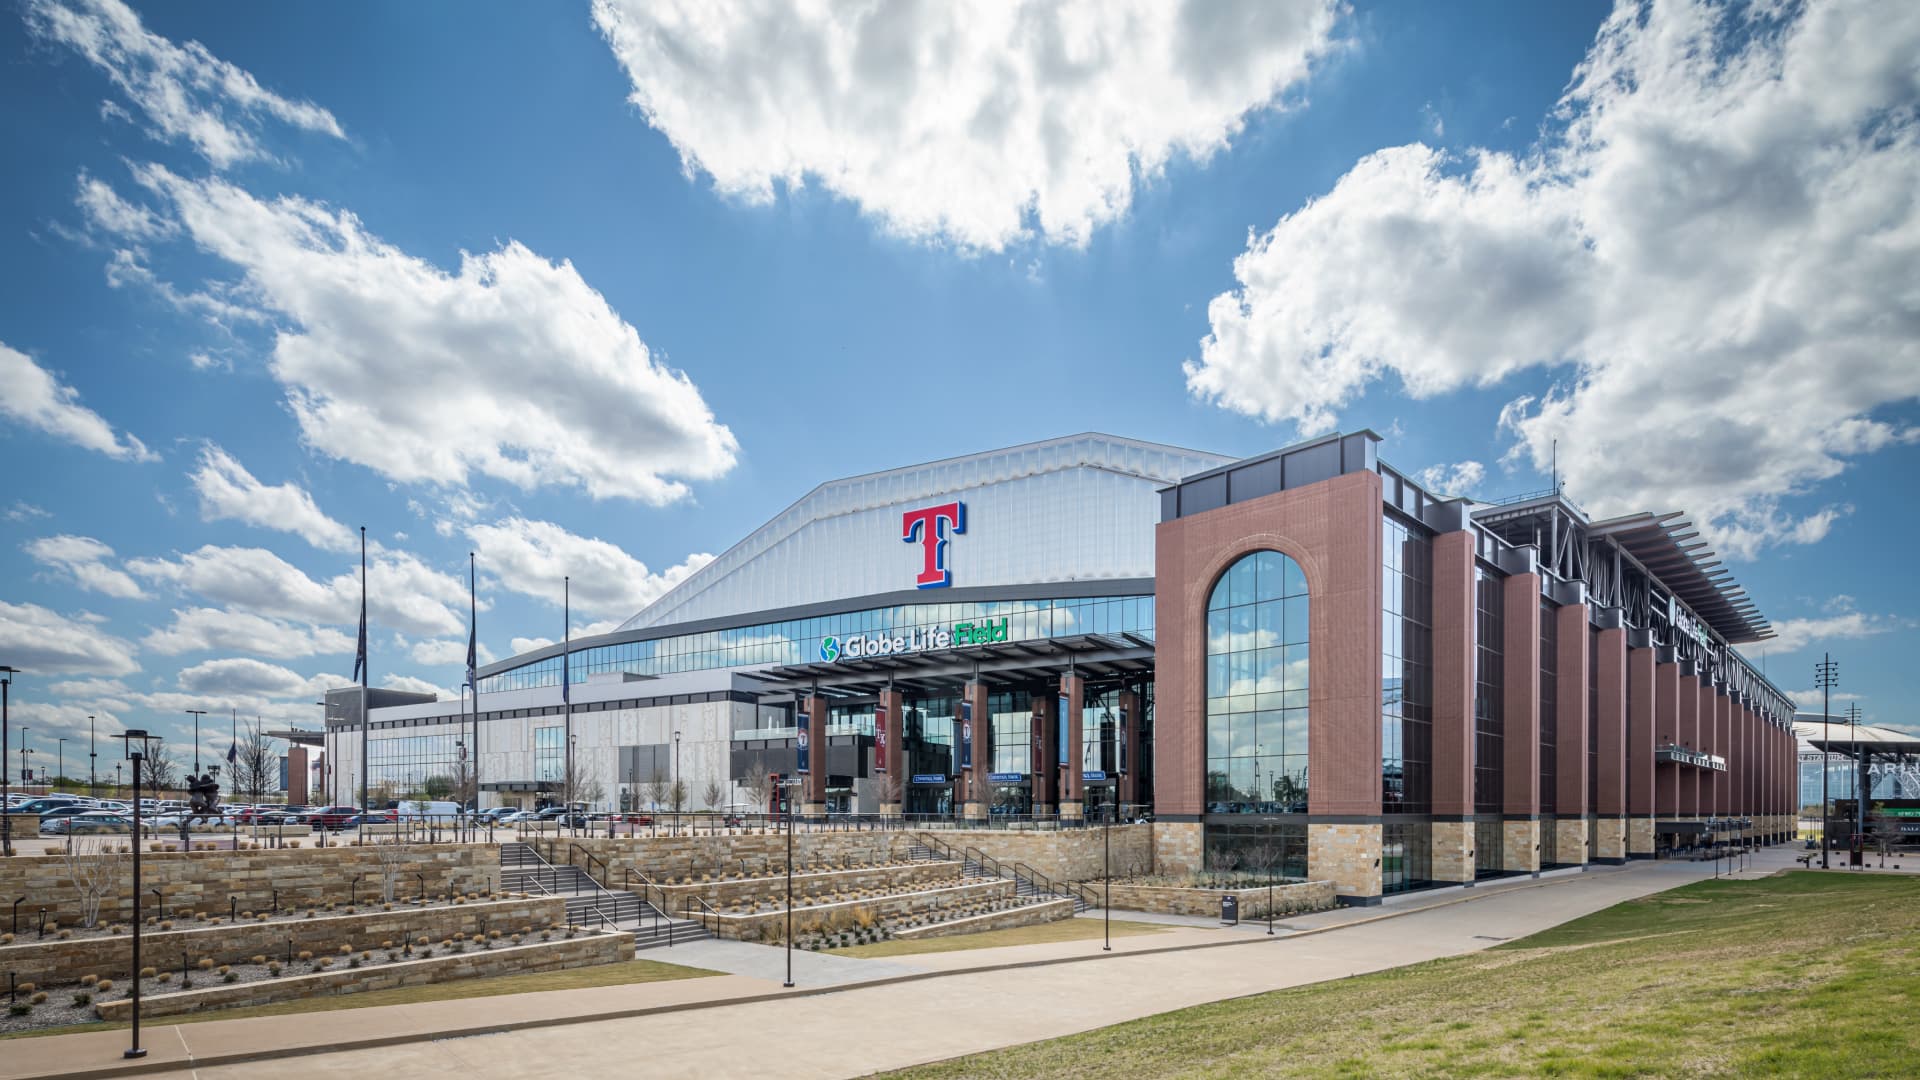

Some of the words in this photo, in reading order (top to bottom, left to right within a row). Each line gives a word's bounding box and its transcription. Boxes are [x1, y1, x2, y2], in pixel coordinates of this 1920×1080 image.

[902, 500, 967, 589] T
[845, 633, 905, 656] Globe
[910, 624, 950, 651] Life
[954, 617, 1008, 647] Field
